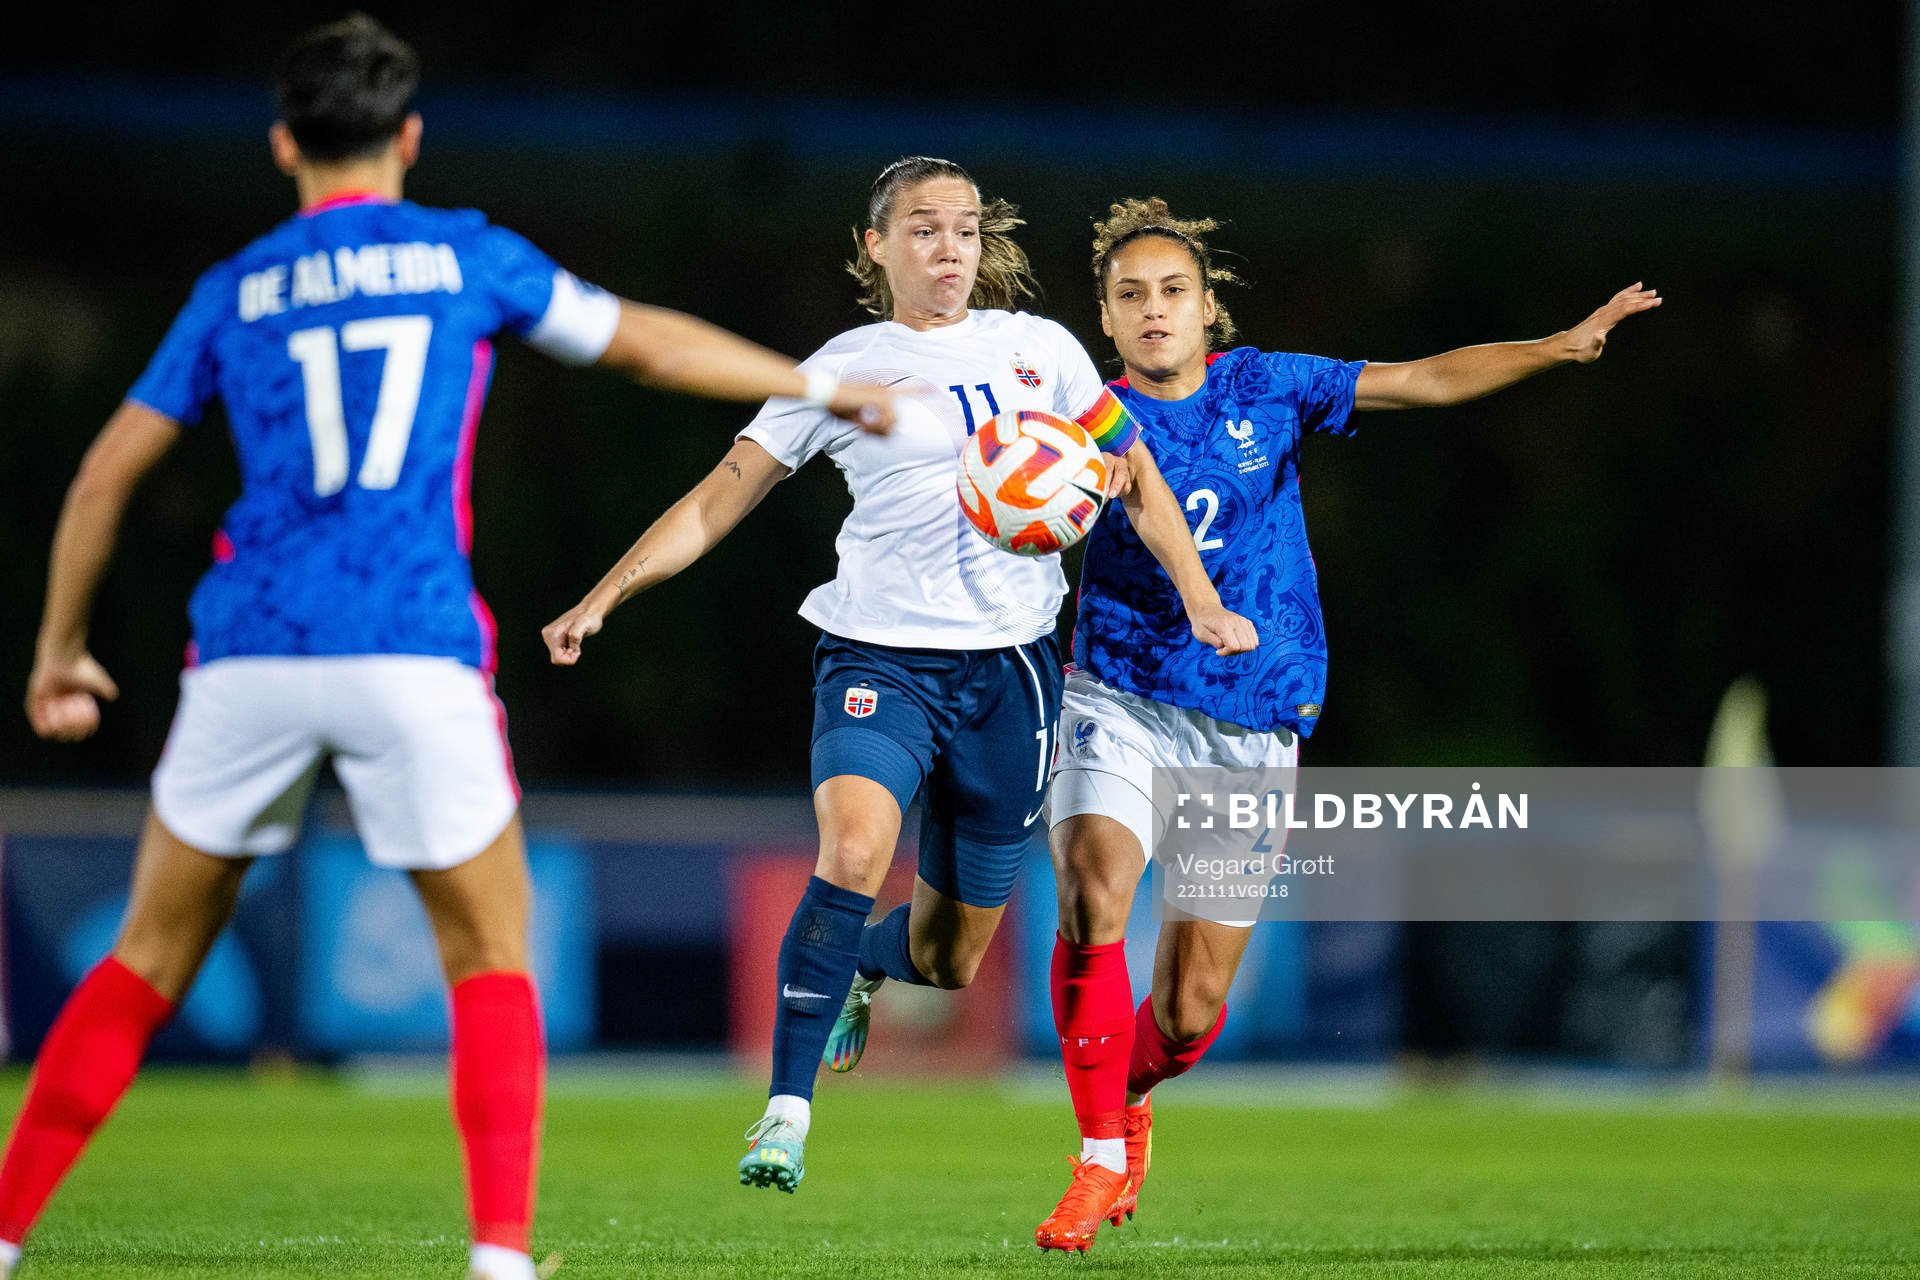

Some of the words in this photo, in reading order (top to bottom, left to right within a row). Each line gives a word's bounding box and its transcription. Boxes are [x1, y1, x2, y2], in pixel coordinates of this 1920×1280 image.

[291, 241, 463, 309] ALMEIDA
[288, 315, 433, 498] 17
[1186, 488, 1224, 552] 2
